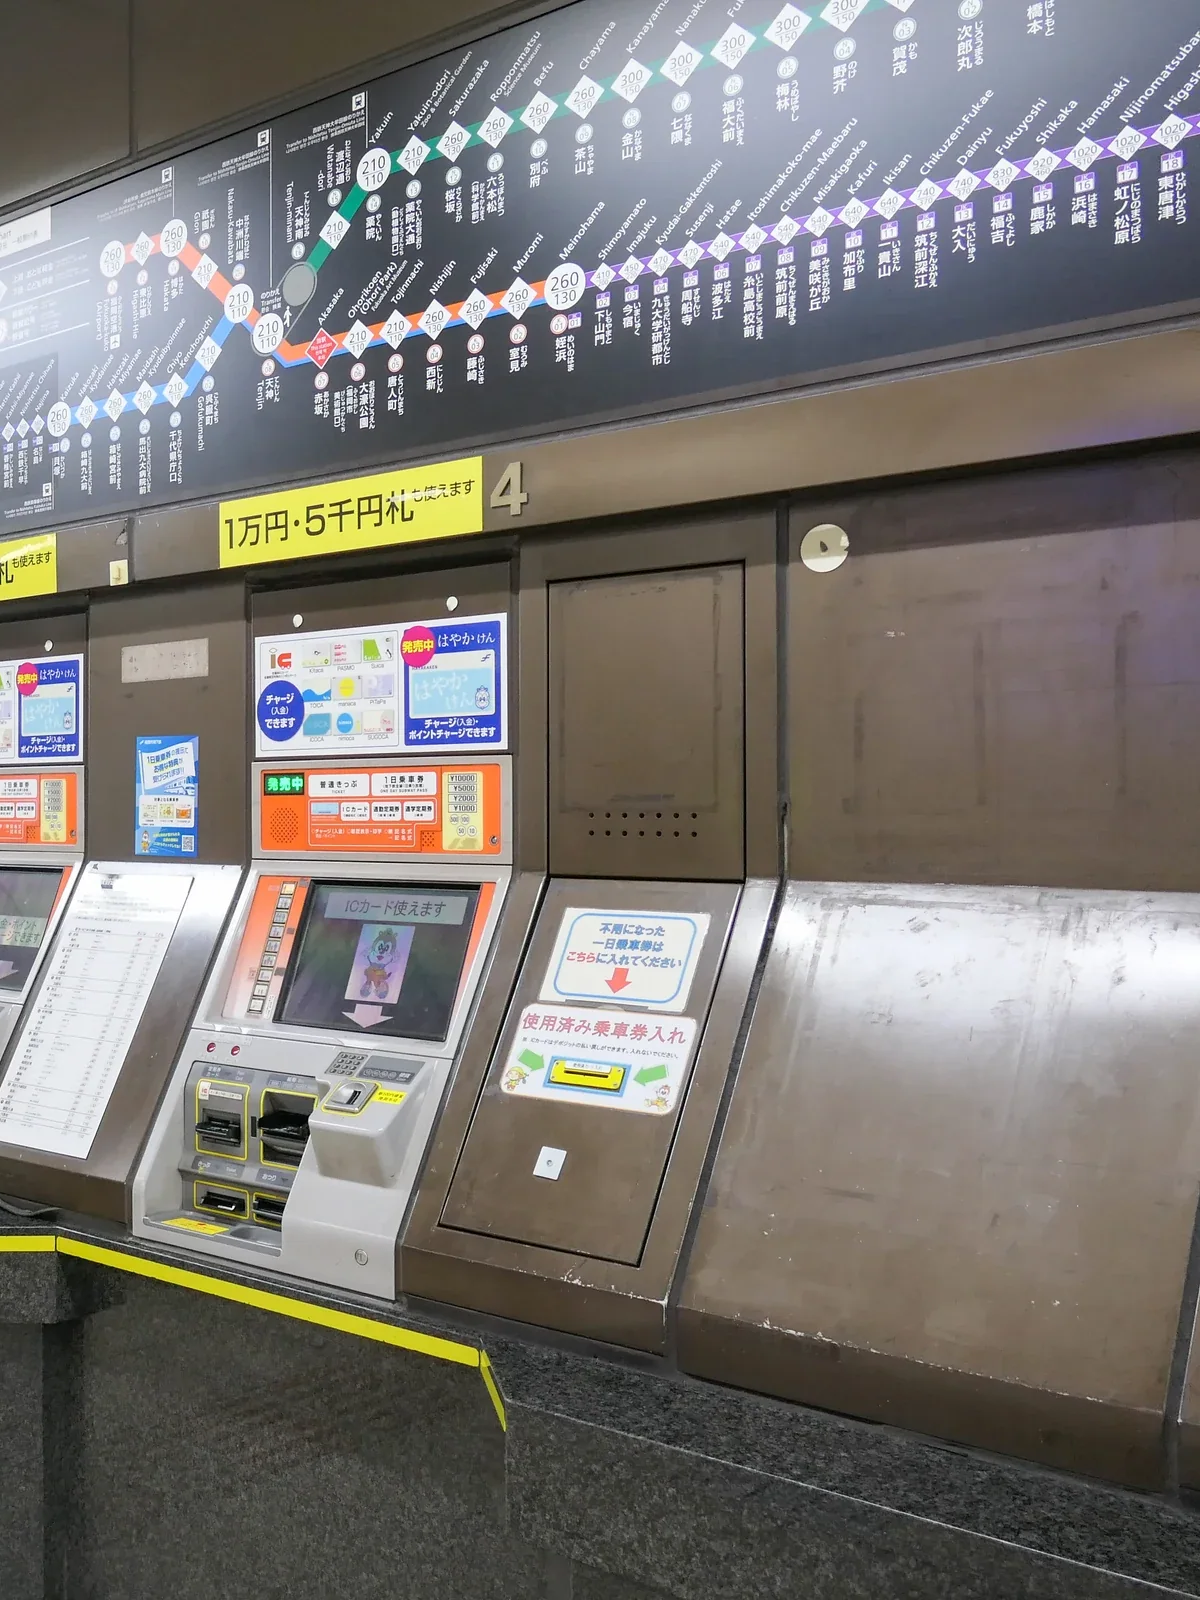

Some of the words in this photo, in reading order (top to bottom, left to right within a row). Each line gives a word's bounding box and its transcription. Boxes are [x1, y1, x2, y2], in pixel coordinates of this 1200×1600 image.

[775, 16, 800, 35] 300
[1027, 3, 1043, 35] 橋本
[579, 21, 616, 71] Chayama
[721, 35, 746, 51] 300
[957, 25, 972, 71] 次郎丸
[490, 31, 541, 102] Ropponmatsu
[534, 61, 554, 86] Befu
[670, 53, 693, 69] 300
[449, 59, 489, 117] Sakurazaka
[621, 70, 643, 86] 300
[407, 69, 452, 132] Yakuin-odori
[574, 87, 595, 102] 260
[776, 83, 789, 112] 梅林
[1077, 76, 1130, 134] Hamasaki
[529, 102, 549, 118] 260
[722, 100, 735, 143] 福大前
[1036, 100, 1078, 145] Shikaka
[369, 111, 394, 145] Yakuin
[485, 117, 505, 132] 260
[919, 89, 995, 175] Chikuzen-Fukae
[995, 97, 1047, 155] Fukuyoshi
[1159, 123, 1186, 137] 1020
[405, 146, 422, 160] 210
[444, 132, 463, 147] 260
[622, 133, 634, 160] 金山
[957, 127, 993, 166] Dainyu
[1115, 134, 1140, 147] 1020
[326, 144, 335, 188] Watanabe
[362, 156, 386, 175] 210
[574, 148, 587, 174] 茶山
[747, 128, 823, 221] Itoshimakoko-mae
[780, 117, 858, 213] Chikuzen-Maebaru
[813, 139, 868, 204] Misakigaoka
[882, 153, 912, 186] Ikisan
[1032, 157, 1053, 168] 920
[365, 172, 383, 186] 110
[530, 163, 540, 188] 別府
[847, 160, 878, 195] Kafuri
[487, 176, 497, 212] 六本松
[655, 159, 723, 246] Kyudai-Gakkentoshi
[1157, 176, 1174, 221] 東唐津
[286, 181, 294, 243] Tenjin-minami
[685, 202, 715, 238] Susenji
[716, 199, 743, 230] Hatae
[1030, 207, 1046, 235] 鹿家
[1071, 196, 1086, 225] 浜崎
[1114, 187, 1130, 245] 虹ノ松原
[165, 226, 183, 242] 260
[327, 221, 344, 234] 210
[559, 201, 606, 260] Meinohama
[598, 198, 647, 260] Shimoyamato
[626, 215, 657, 253] Imajuku
[952, 225, 966, 253] 大入
[991, 215, 1004, 244] 福吉
[470, 247, 499, 285] Fujisaki
[513, 232, 544, 273] Muromi
[914, 234, 928, 289] 筑前深江
[379, 262, 397, 286] Park)
[391, 259, 424, 305] Tojinmachi
[429, 260, 457, 296] Nishijin
[552, 272, 579, 291] 260
[843, 251, 856, 291] 加布里
[229, 291, 248, 307] 210
[348, 271, 382, 318] Ohorikoen
[509, 289, 528, 304] 260
[554, 290, 577, 305] 130
[775, 268, 787, 318] 筑前前原
[809, 260, 821, 312] 美咲が丘
[232, 306, 247, 319] 110
[318, 287, 345, 326] Akasaka
[466, 299, 485, 314] 260
[512, 303, 526, 313] 130
[681, 290, 693, 326] 周船寺
[712, 284, 723, 320] 波多江
[743, 276, 755, 338] 糸島高校前
[258, 320, 278, 338] 210
[387, 321, 405, 334] 210
[425, 311, 443, 324] 260
[595, 311, 605, 346] 下山門
[623, 305, 634, 328] 今宿
[260, 336, 277, 348] 110
[350, 331, 367, 343] 210
[107, 354, 130, 389] Hakozaki
[167, 351, 183, 373] Chiyo
[510, 348, 520, 373] 室見
[60, 372, 80, 402] Kaizuka
[78, 365, 99, 397] Hakozaki
[266, 378, 273, 400] 天神
[426, 367, 436, 391] 西新
[314, 393, 323, 415] 赤坂
[388, 376, 397, 411] 唐人町
[51, 409, 67, 422] 260
[490, 462, 528, 515] 4
[402, 639, 433, 653] 発売中
[17, 674, 38, 684] 発売中
[266, 693, 294, 705] チャージ
[265, 718, 295, 728] できます
[409, 727, 496, 740] ポイントチャージできます
[267, 778, 303, 791] 発売中
[320, 780, 358, 788] 普通きっぷ
[384, 775, 424, 784] 1日乗車券
[345, 900, 446, 917] ICカード使えます
[600, 923, 665, 936] 不用になった
[593, 939, 664, 951] 一日乗車券は
[566, 952, 682, 968] こちらに入れてください
[523, 1013, 686, 1044] 使用済み乗車券入れ
